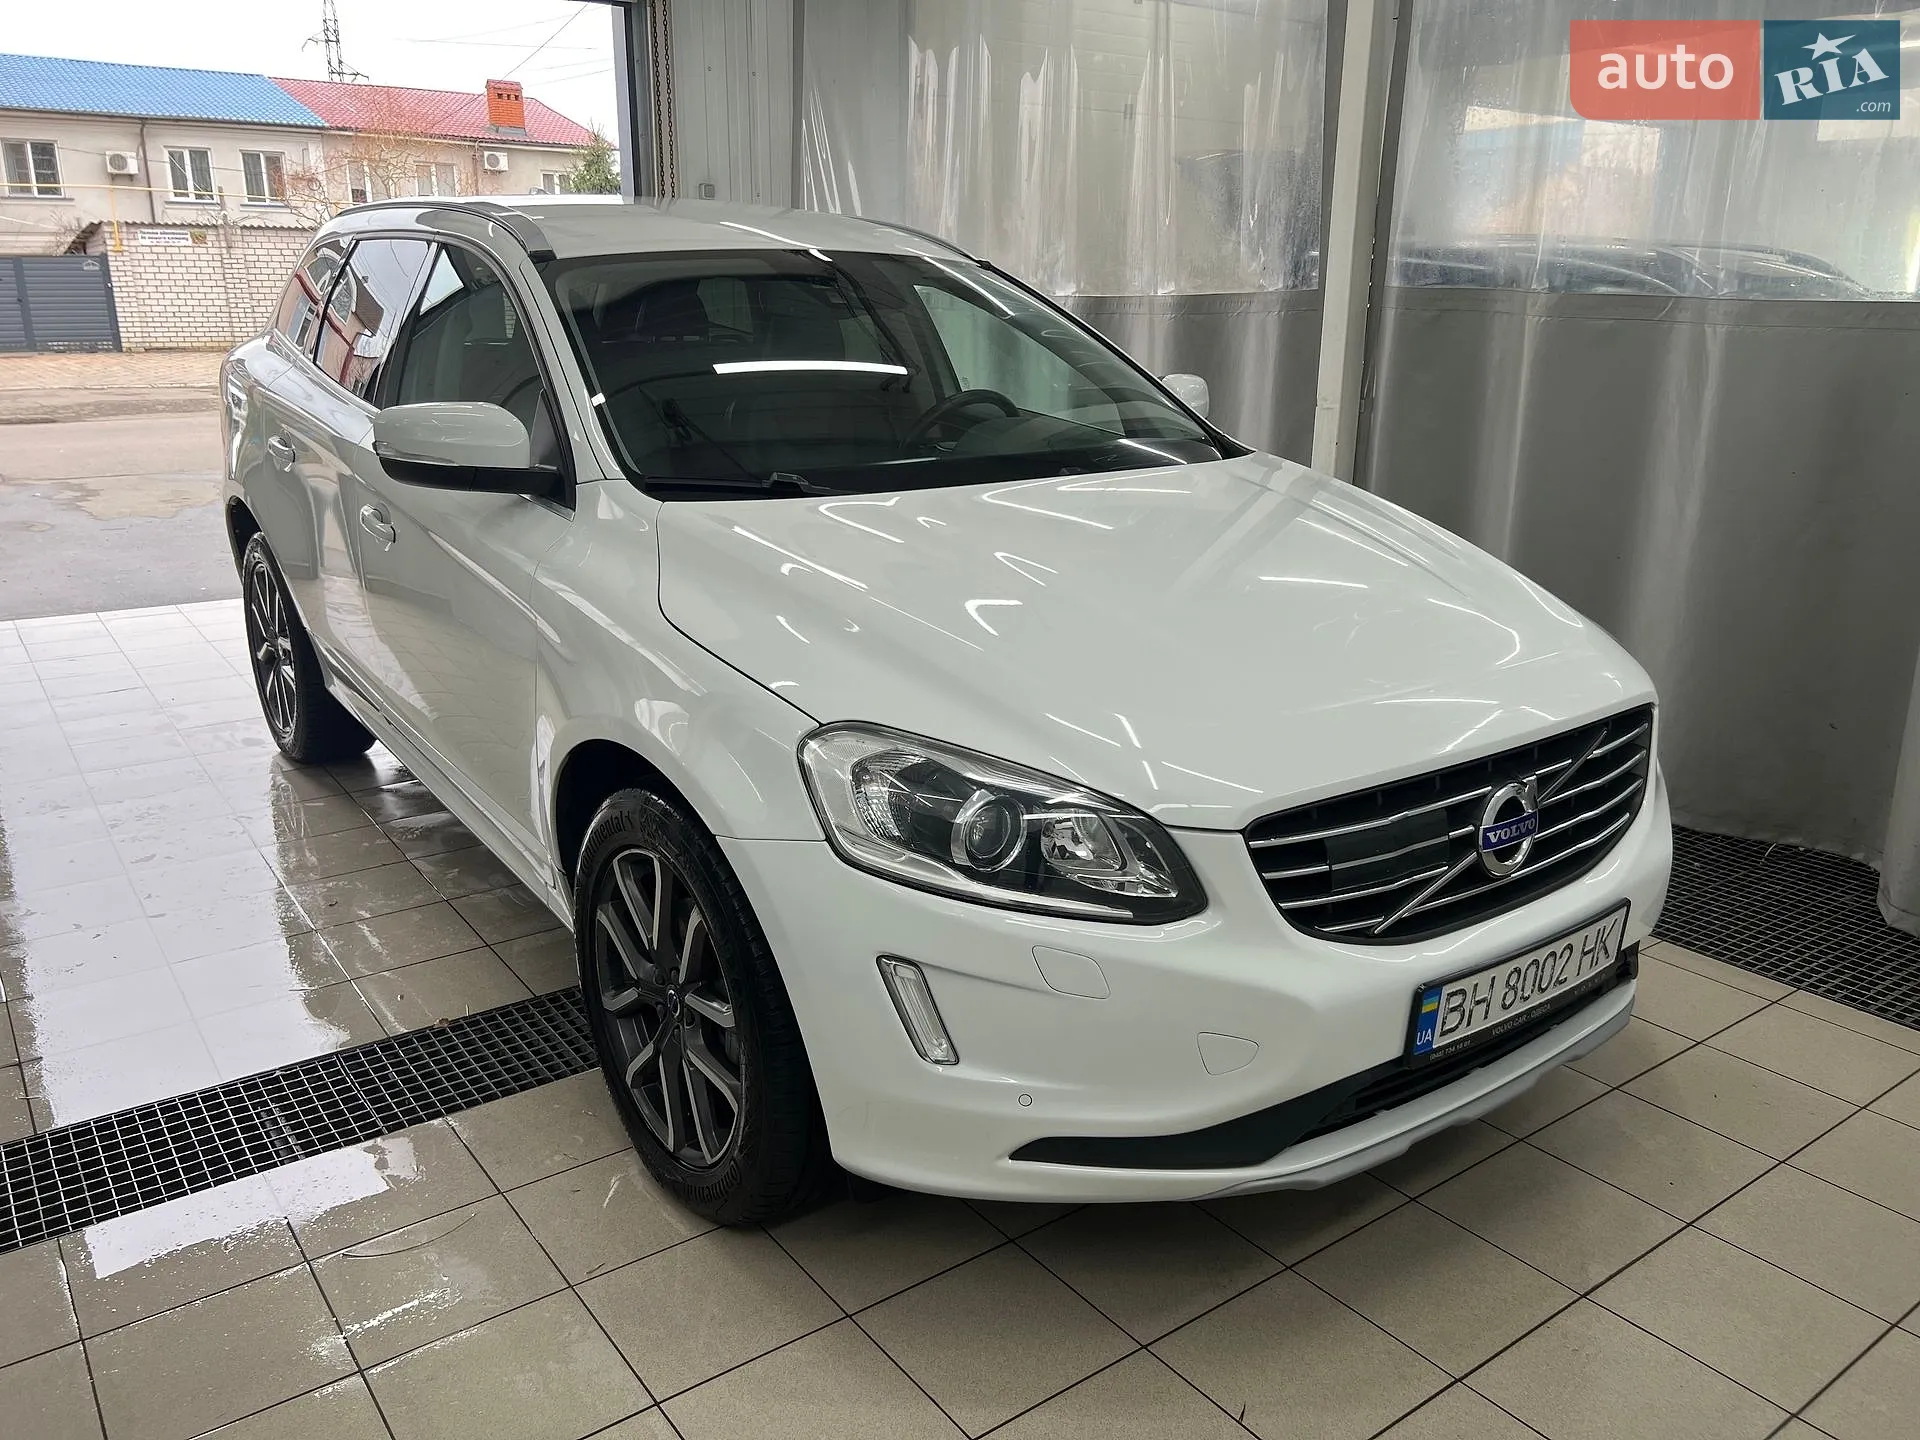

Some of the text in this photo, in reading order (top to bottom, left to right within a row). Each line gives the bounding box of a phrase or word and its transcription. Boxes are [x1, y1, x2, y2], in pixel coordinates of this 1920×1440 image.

[1486, 818, 1536, 844] VOLVO
[1439, 975, 1496, 1037] BH
[1501, 943, 1573, 1010] 8002
[1576, 918, 1618, 976] HK
[1417, 1028, 1432, 1045] UA
